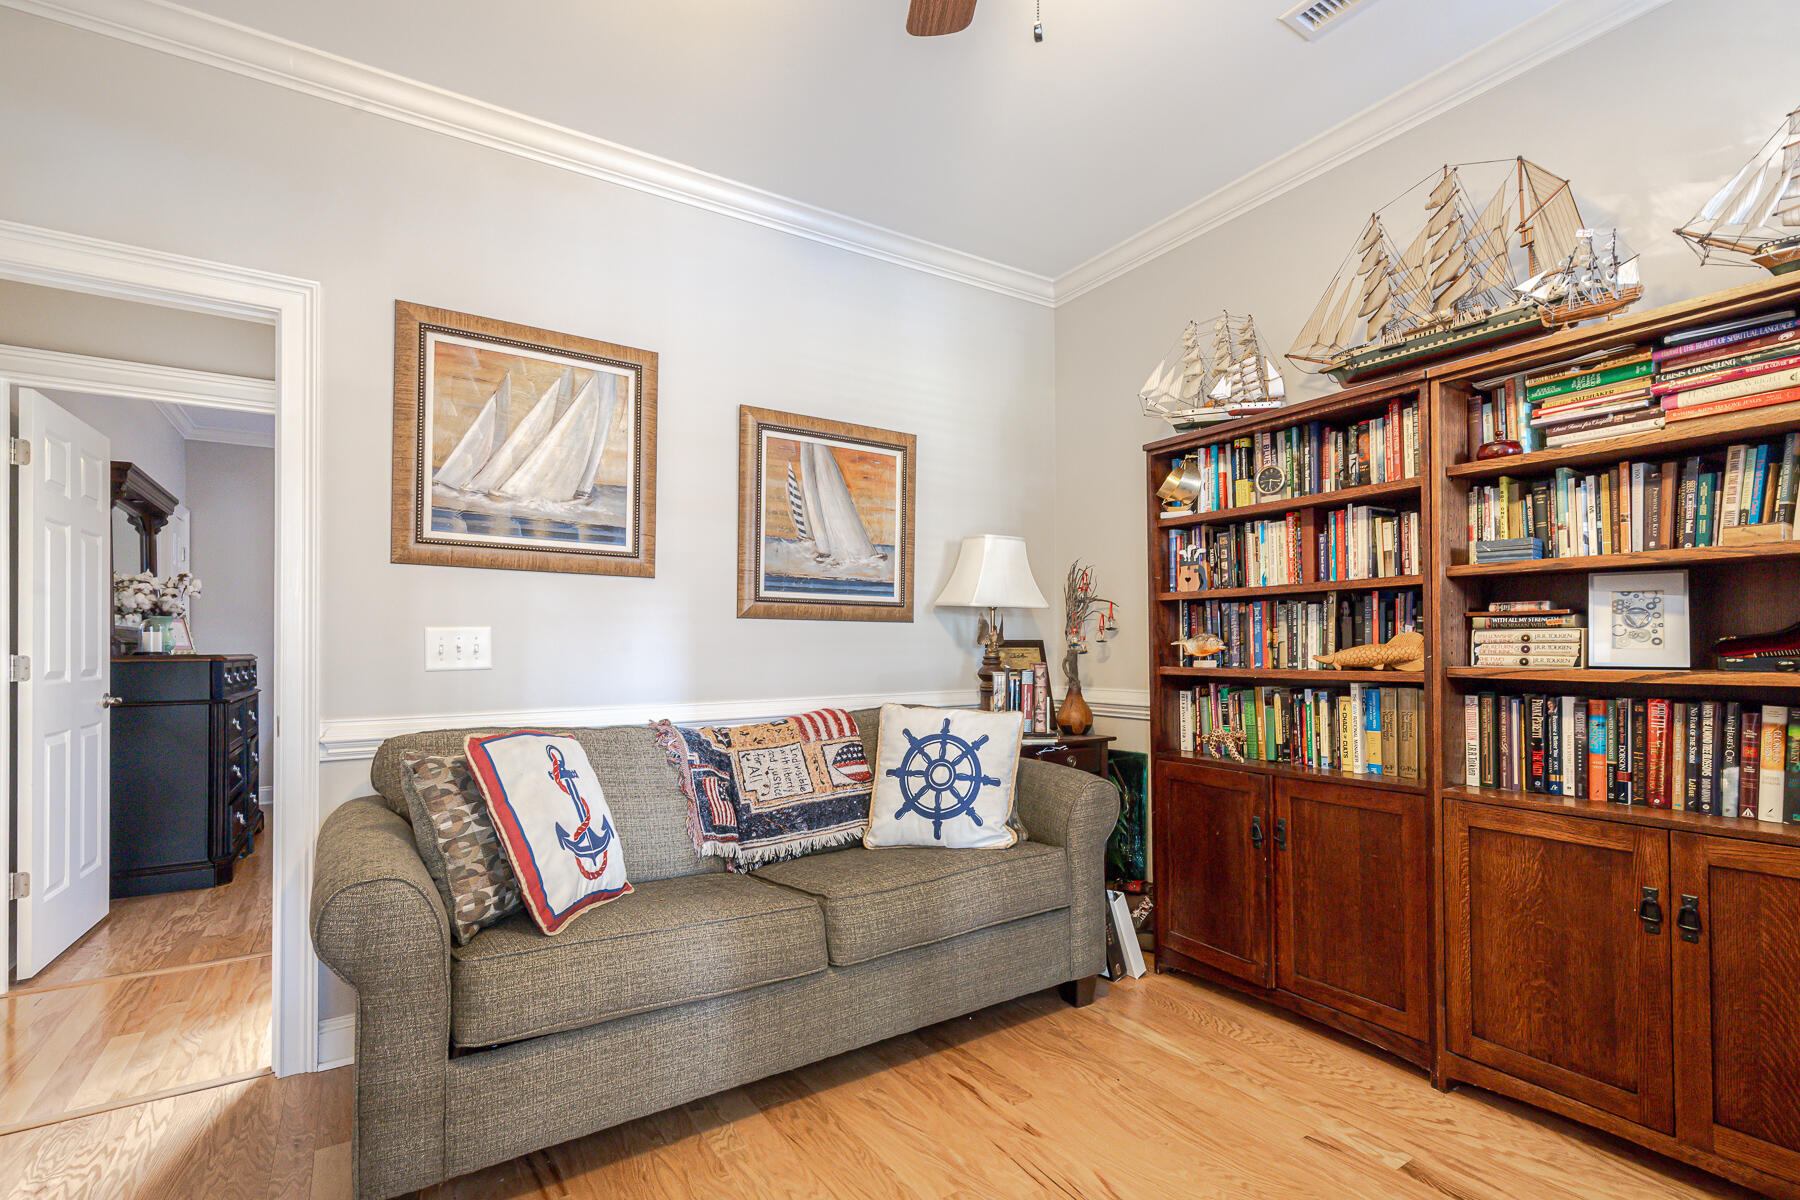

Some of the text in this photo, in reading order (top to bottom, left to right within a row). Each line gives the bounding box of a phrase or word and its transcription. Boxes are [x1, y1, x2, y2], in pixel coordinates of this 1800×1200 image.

[1696, 337, 1717, 350] BEAUTY
[1727, 329, 1758, 342] SPIRITUAL
[1759, 322, 1794, 336] LANGUAGE
[1660, 358, 1736, 381] CRISIS COUNSELING
[1532, 698, 1544, 738] FRANK PERETTI
[1650, 702, 1666, 728] PERETTI
[1702, 704, 1713, 718] WHEN
[1590, 720, 1598, 749] RISING
[1702, 726, 1713, 744] ALMOND
[1724, 726, 1735, 750] HEART'S
[1772, 730, 1783, 763] GLORIOUS
[752, 752, 765, 766] for
[1532, 750, 1544, 776] THE OATH
[1688, 746, 1697, 764] STORM
[1702, 754, 1713, 776] BLOSSOMS
[1725, 750, 1735, 764] CRY
[748, 766, 763, 784] All
[768, 750, 782, 796] and justice
[780, 748, 796, 792] with liberty
[790, 746, 808, 792] Indivisible
